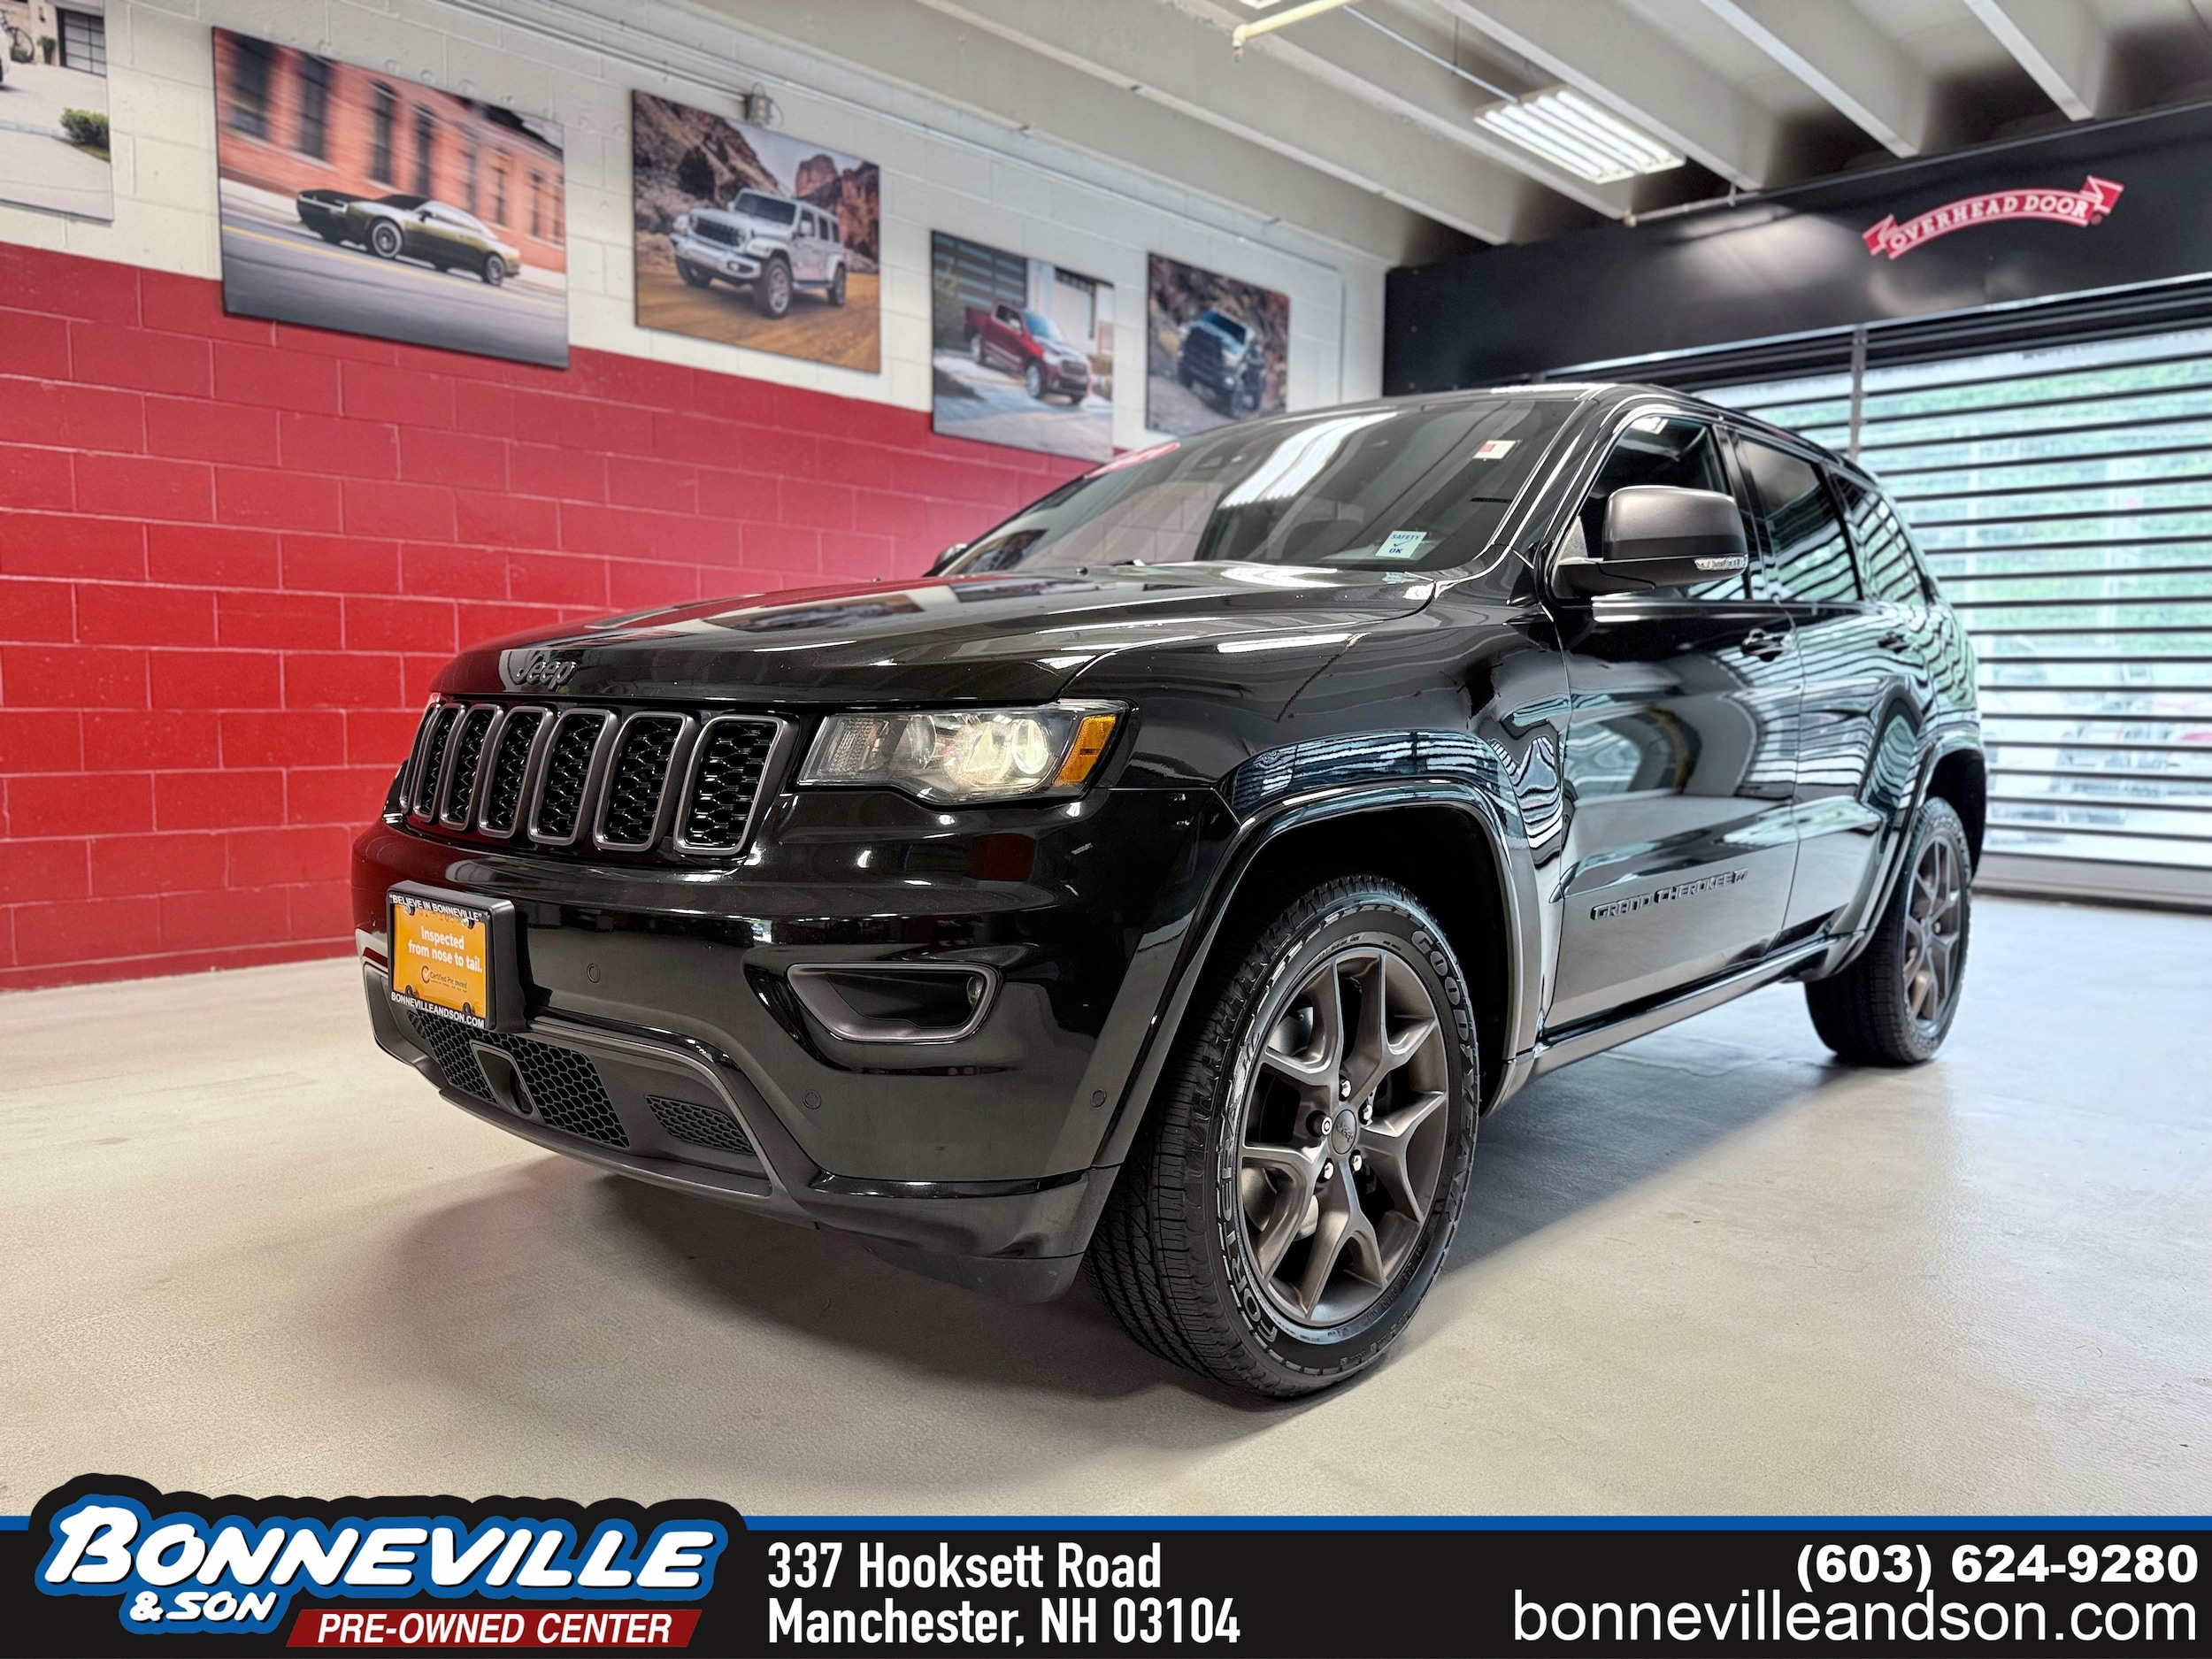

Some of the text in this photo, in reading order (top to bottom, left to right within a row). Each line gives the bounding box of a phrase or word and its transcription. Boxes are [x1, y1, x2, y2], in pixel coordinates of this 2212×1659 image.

[1889, 195, 2089, 250] OVERHEAD DOOR
[513, 653, 578, 691] Jeep
[422, 901, 432, 911] IN
[1591, 872, 1733, 920] GRAND CHEROKEE
[408, 940, 483, 973] from nose to tail.
[420, 926, 465, 950] Inspected
[390, 991, 486, 1030] BONNEVILLEANDSON.COM
[1410, 929, 1476, 1223] GOODYEAR
